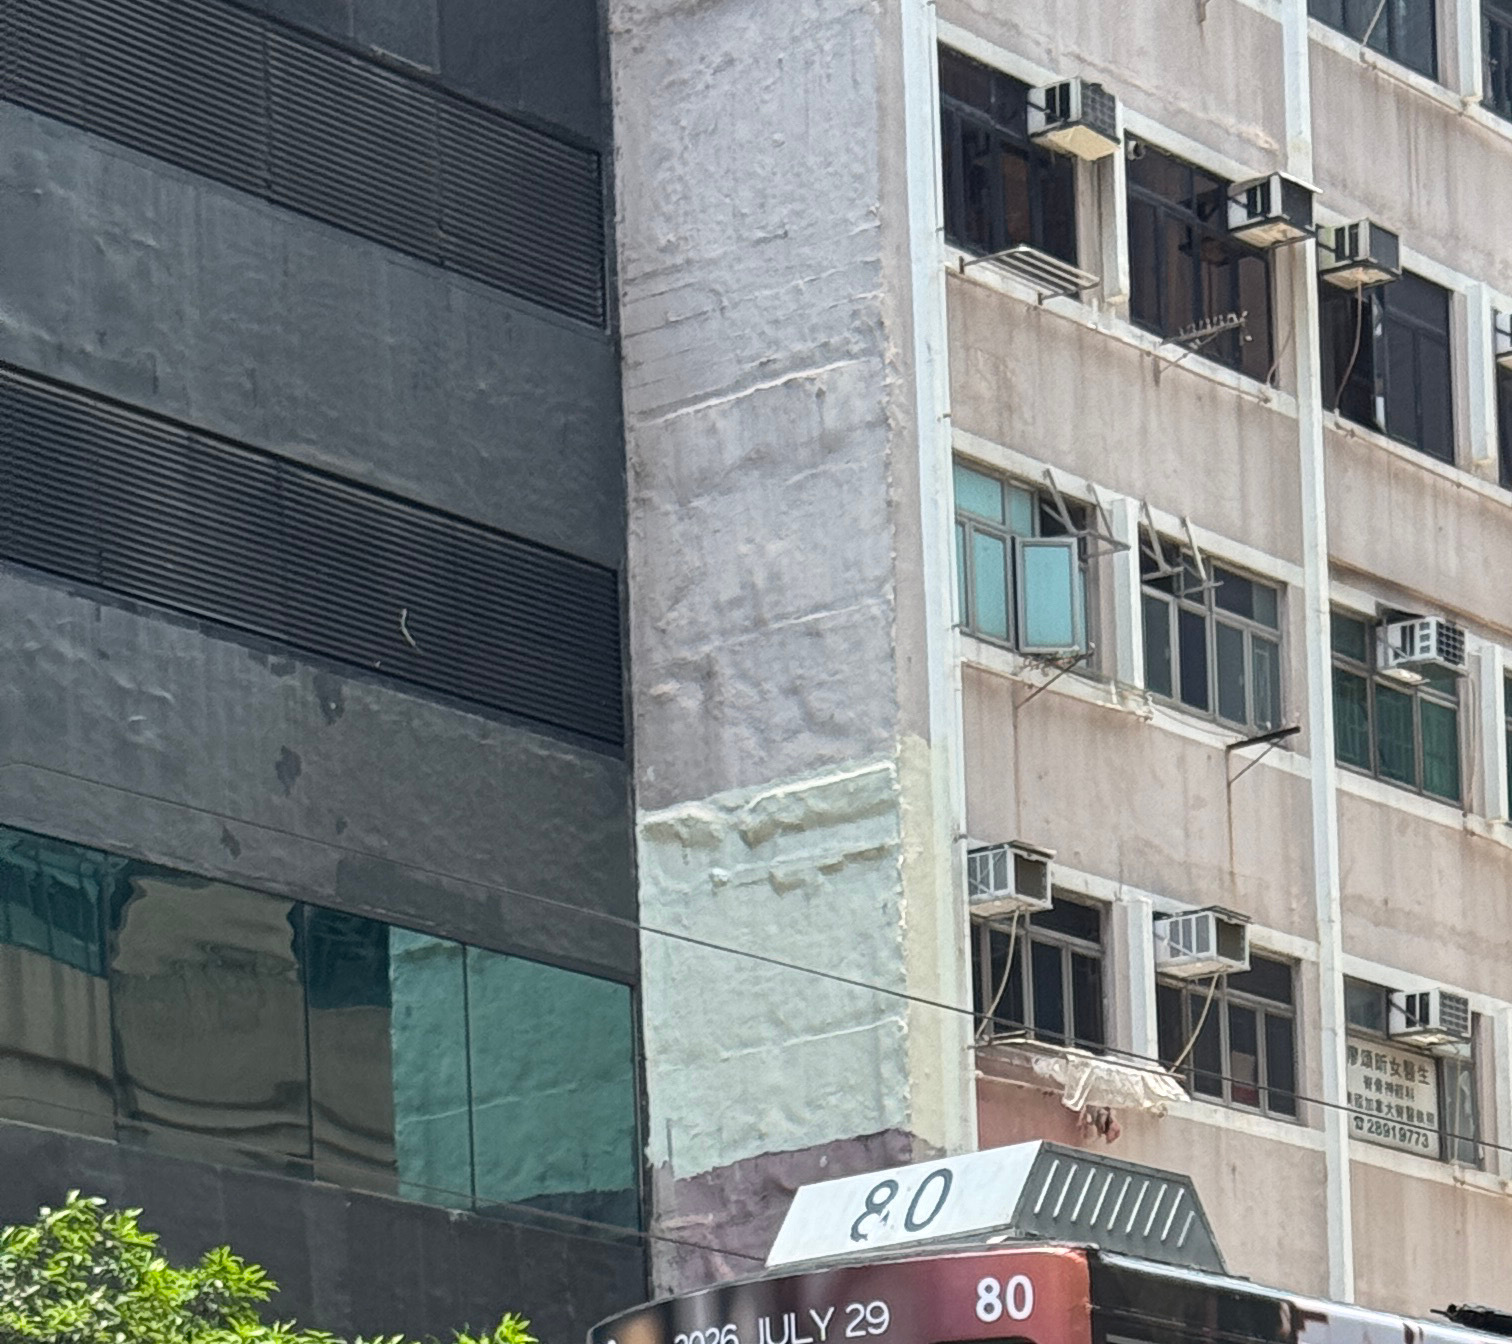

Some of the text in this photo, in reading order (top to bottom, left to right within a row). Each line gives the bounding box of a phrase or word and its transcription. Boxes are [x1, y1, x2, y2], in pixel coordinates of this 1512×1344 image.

[850, 1168, 953, 1242] 80
[844, 1300, 890, 1337] 29
[975, 1274, 1034, 1322] 80
